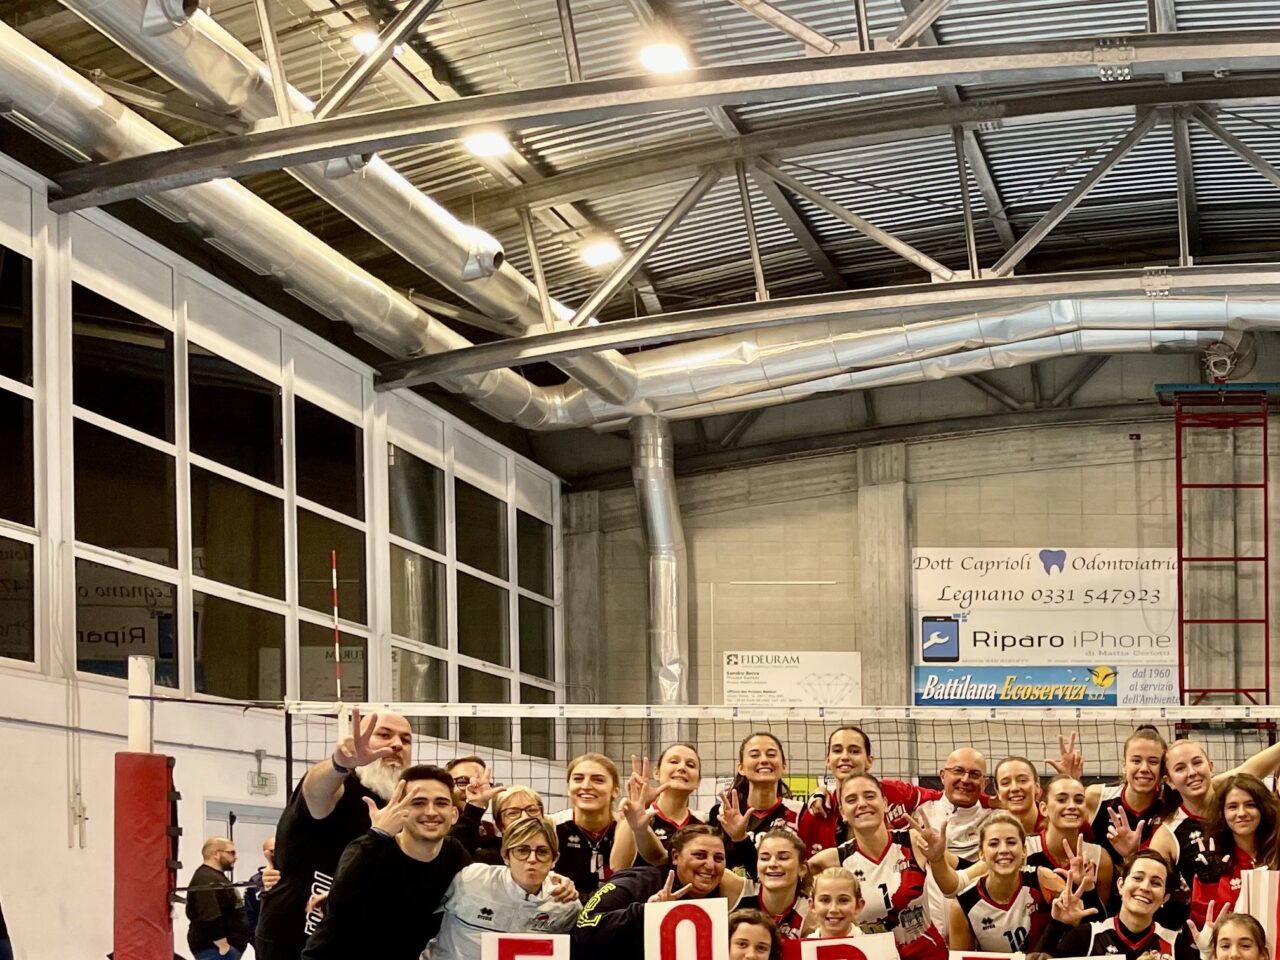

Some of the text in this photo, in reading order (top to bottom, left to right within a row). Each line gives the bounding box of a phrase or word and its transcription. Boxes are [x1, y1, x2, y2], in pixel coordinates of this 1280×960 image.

[912, 556, 954, 570] Dott
[961, 553, 1032, 577] Caprioli
[937, 586, 1160, 609] Legnano 0331 547923
[973, 631, 1171, 651] Riparo iPhone
[741, 655, 800, 664] FIDEURAM
[1132, 668, 1171, 679] dal 1960
[921, 674, 997, 700] Battilana
[1000, 675, 1088, 702] Ecoservizi
[1140, 683, 1173, 692] servizio
[877, 883, 893, 911] 1
[1003, 927, 1027, 953] 10
